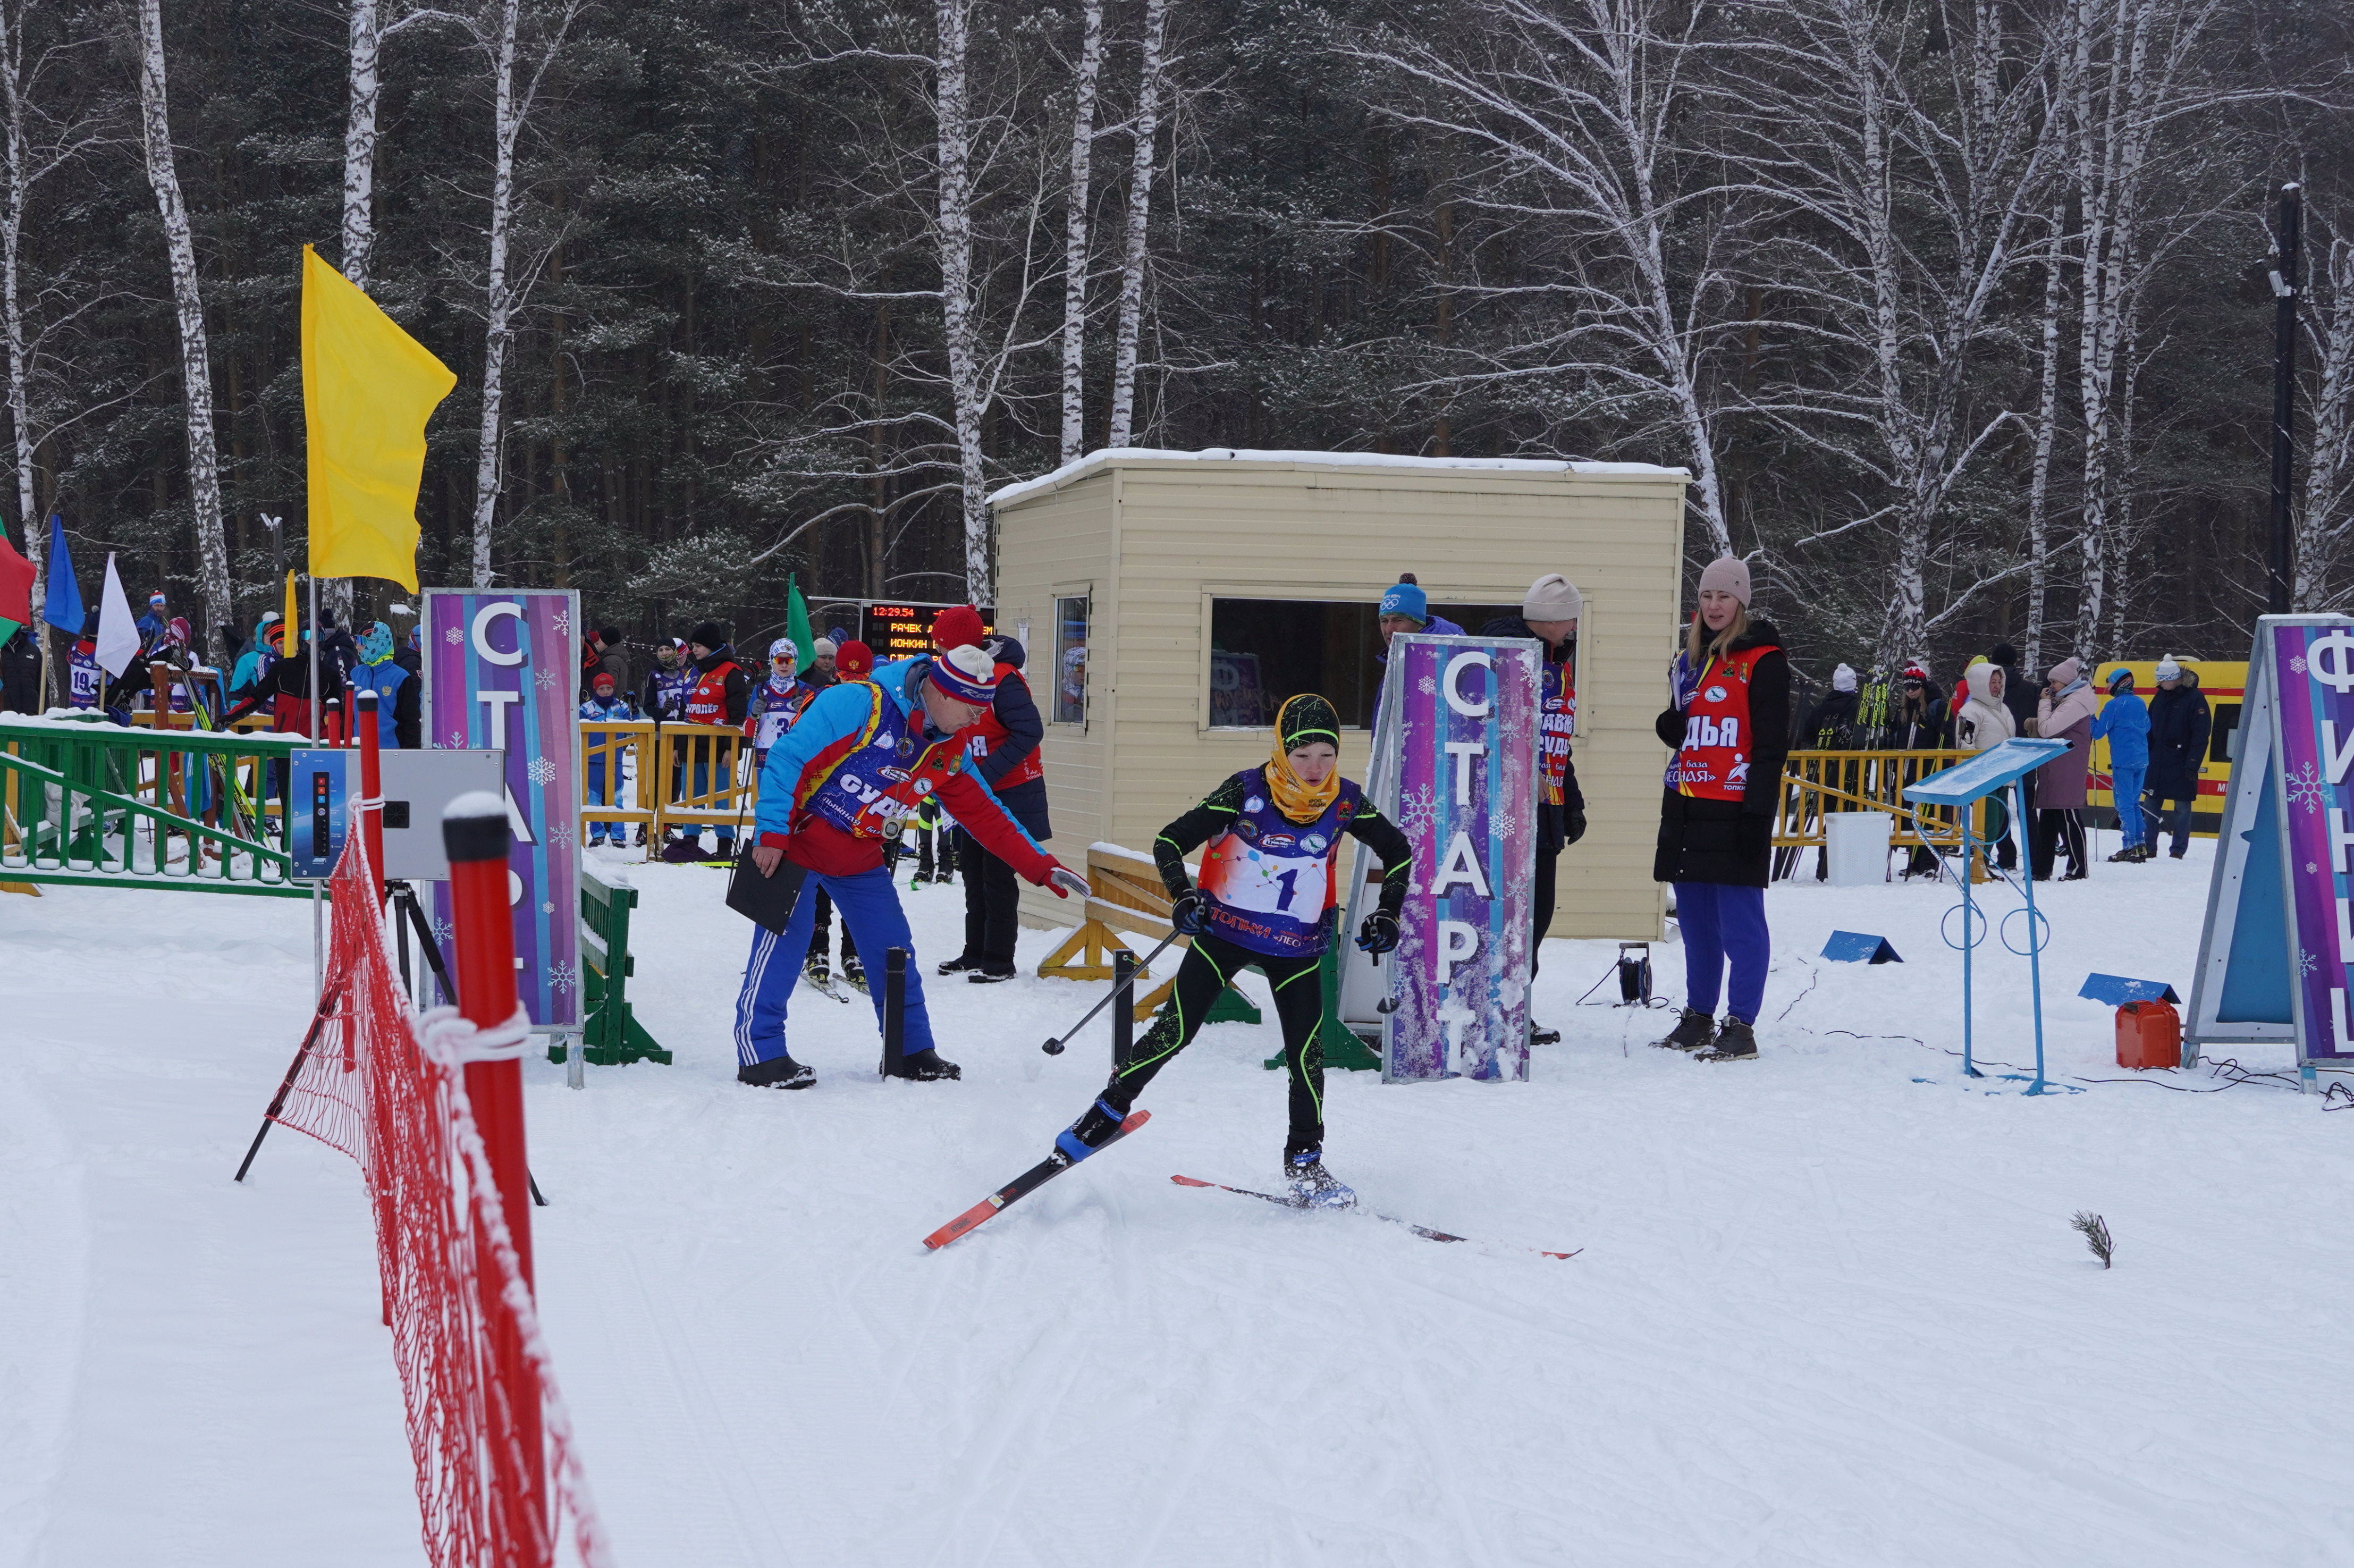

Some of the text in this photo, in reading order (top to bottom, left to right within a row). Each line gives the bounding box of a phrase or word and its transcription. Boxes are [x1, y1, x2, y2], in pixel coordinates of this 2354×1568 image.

[873, 607, 914, 618] 12:29.54
[891, 623, 922, 633] РАЧЕК
[890, 638, 927, 648] ИОНКИН
[74, 671, 89, 691] 19
[1857, 682, 1869, 726] FISCHER
[1862, 682, 1872, 724] FISCHER
[1871, 685, 1881, 728] FISCHER
[1430, 652, 1491, 1073] СТАРТ
[1276, 869, 1298, 912] 1
[1211, 906, 1271, 939] ТОПКИ
[950, 1218, 971, 1233] ATOMIC
